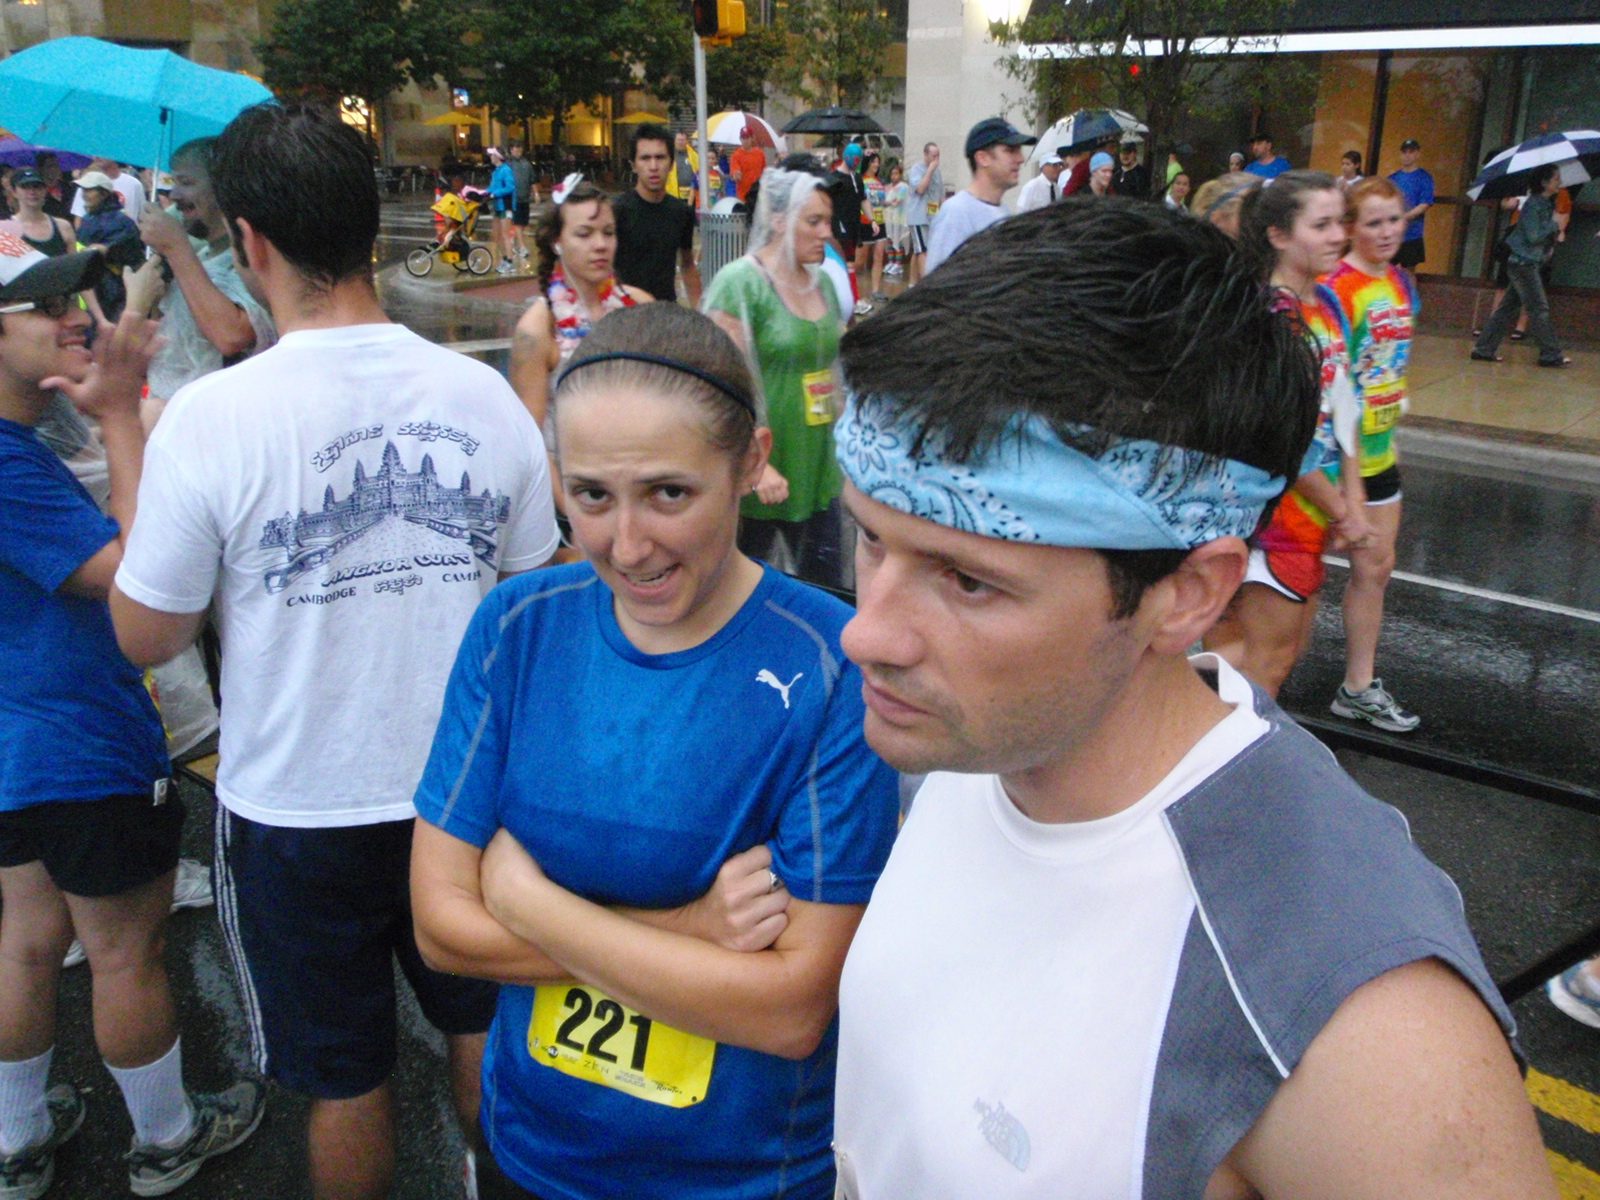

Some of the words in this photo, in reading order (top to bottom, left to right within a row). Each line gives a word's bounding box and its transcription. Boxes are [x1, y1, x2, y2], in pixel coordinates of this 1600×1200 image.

[321, 558, 412, 587] ANGKOR
[414, 553, 470, 568] WAT
[286, 586, 357, 607] CAMBODGE
[555, 987, 652, 1072] 221
